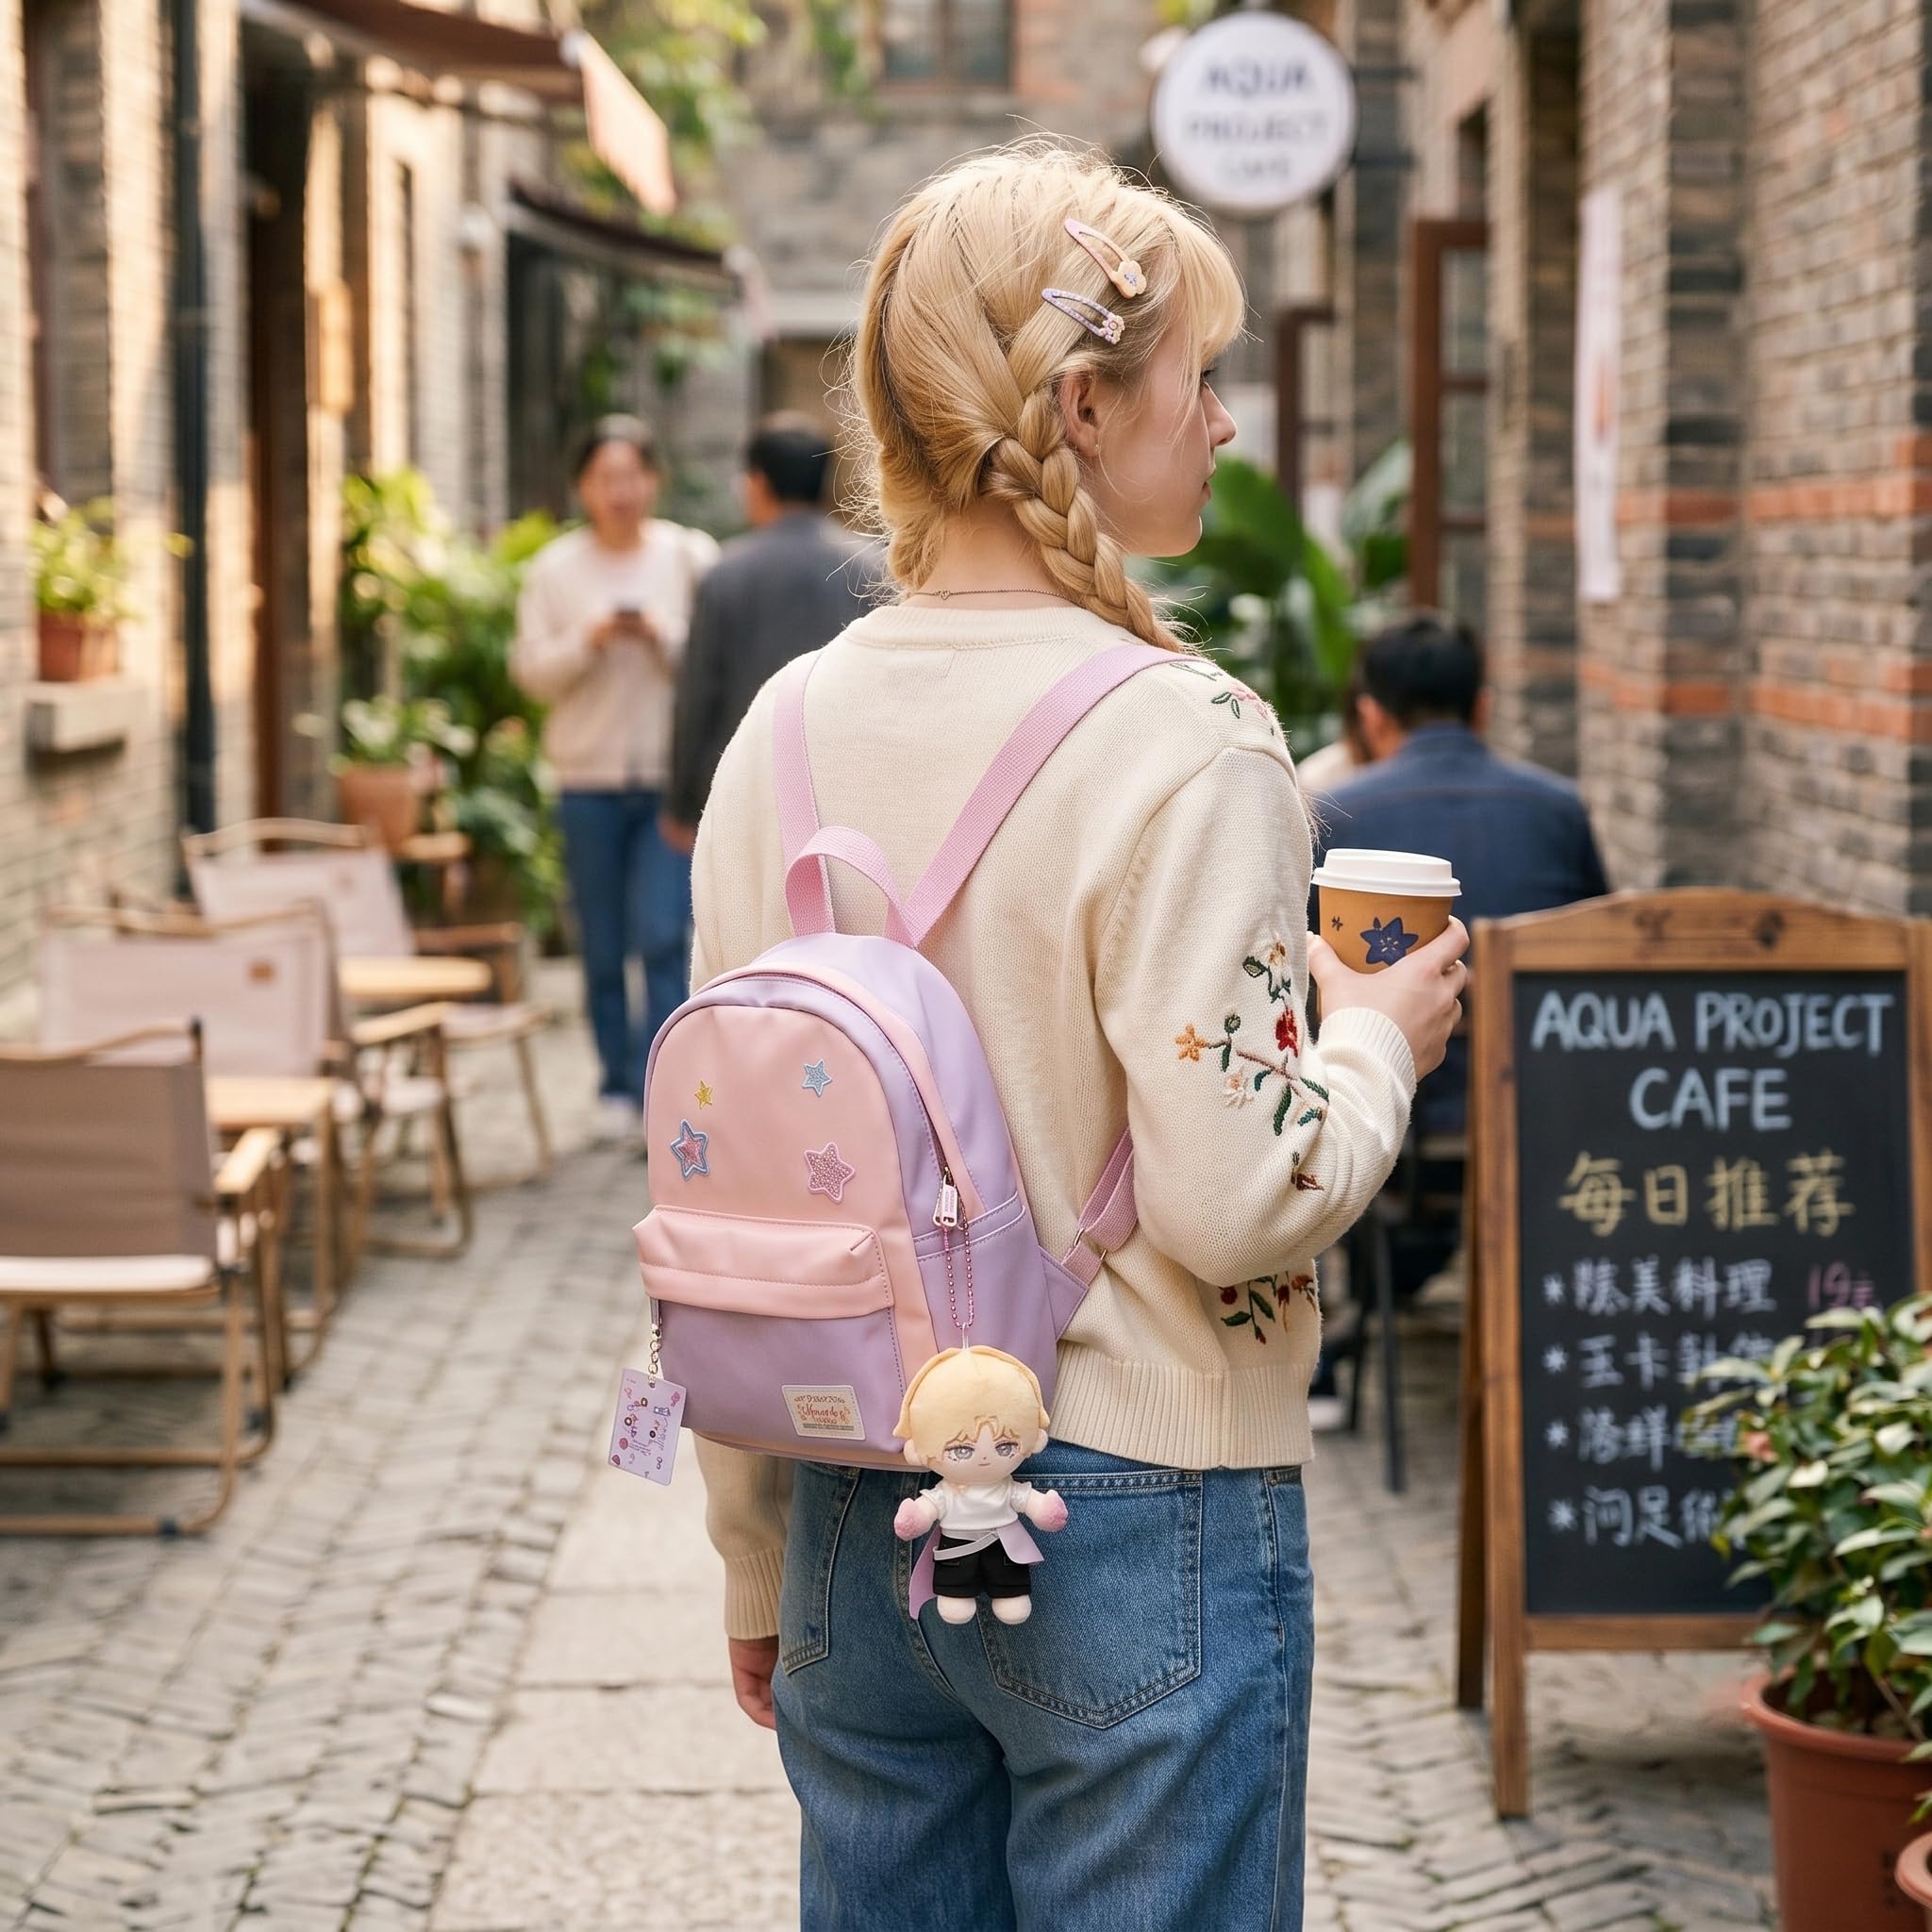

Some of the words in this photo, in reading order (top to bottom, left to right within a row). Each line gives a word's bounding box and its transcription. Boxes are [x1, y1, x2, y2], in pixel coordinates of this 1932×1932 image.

[1530, 990, 1677, 1052] AQUA
[1694, 991, 1895, 1058] PROJECT
[1628, 1067, 1792, 1131] CAFE
[1557, 1149, 1856, 1236] 每日推荐
